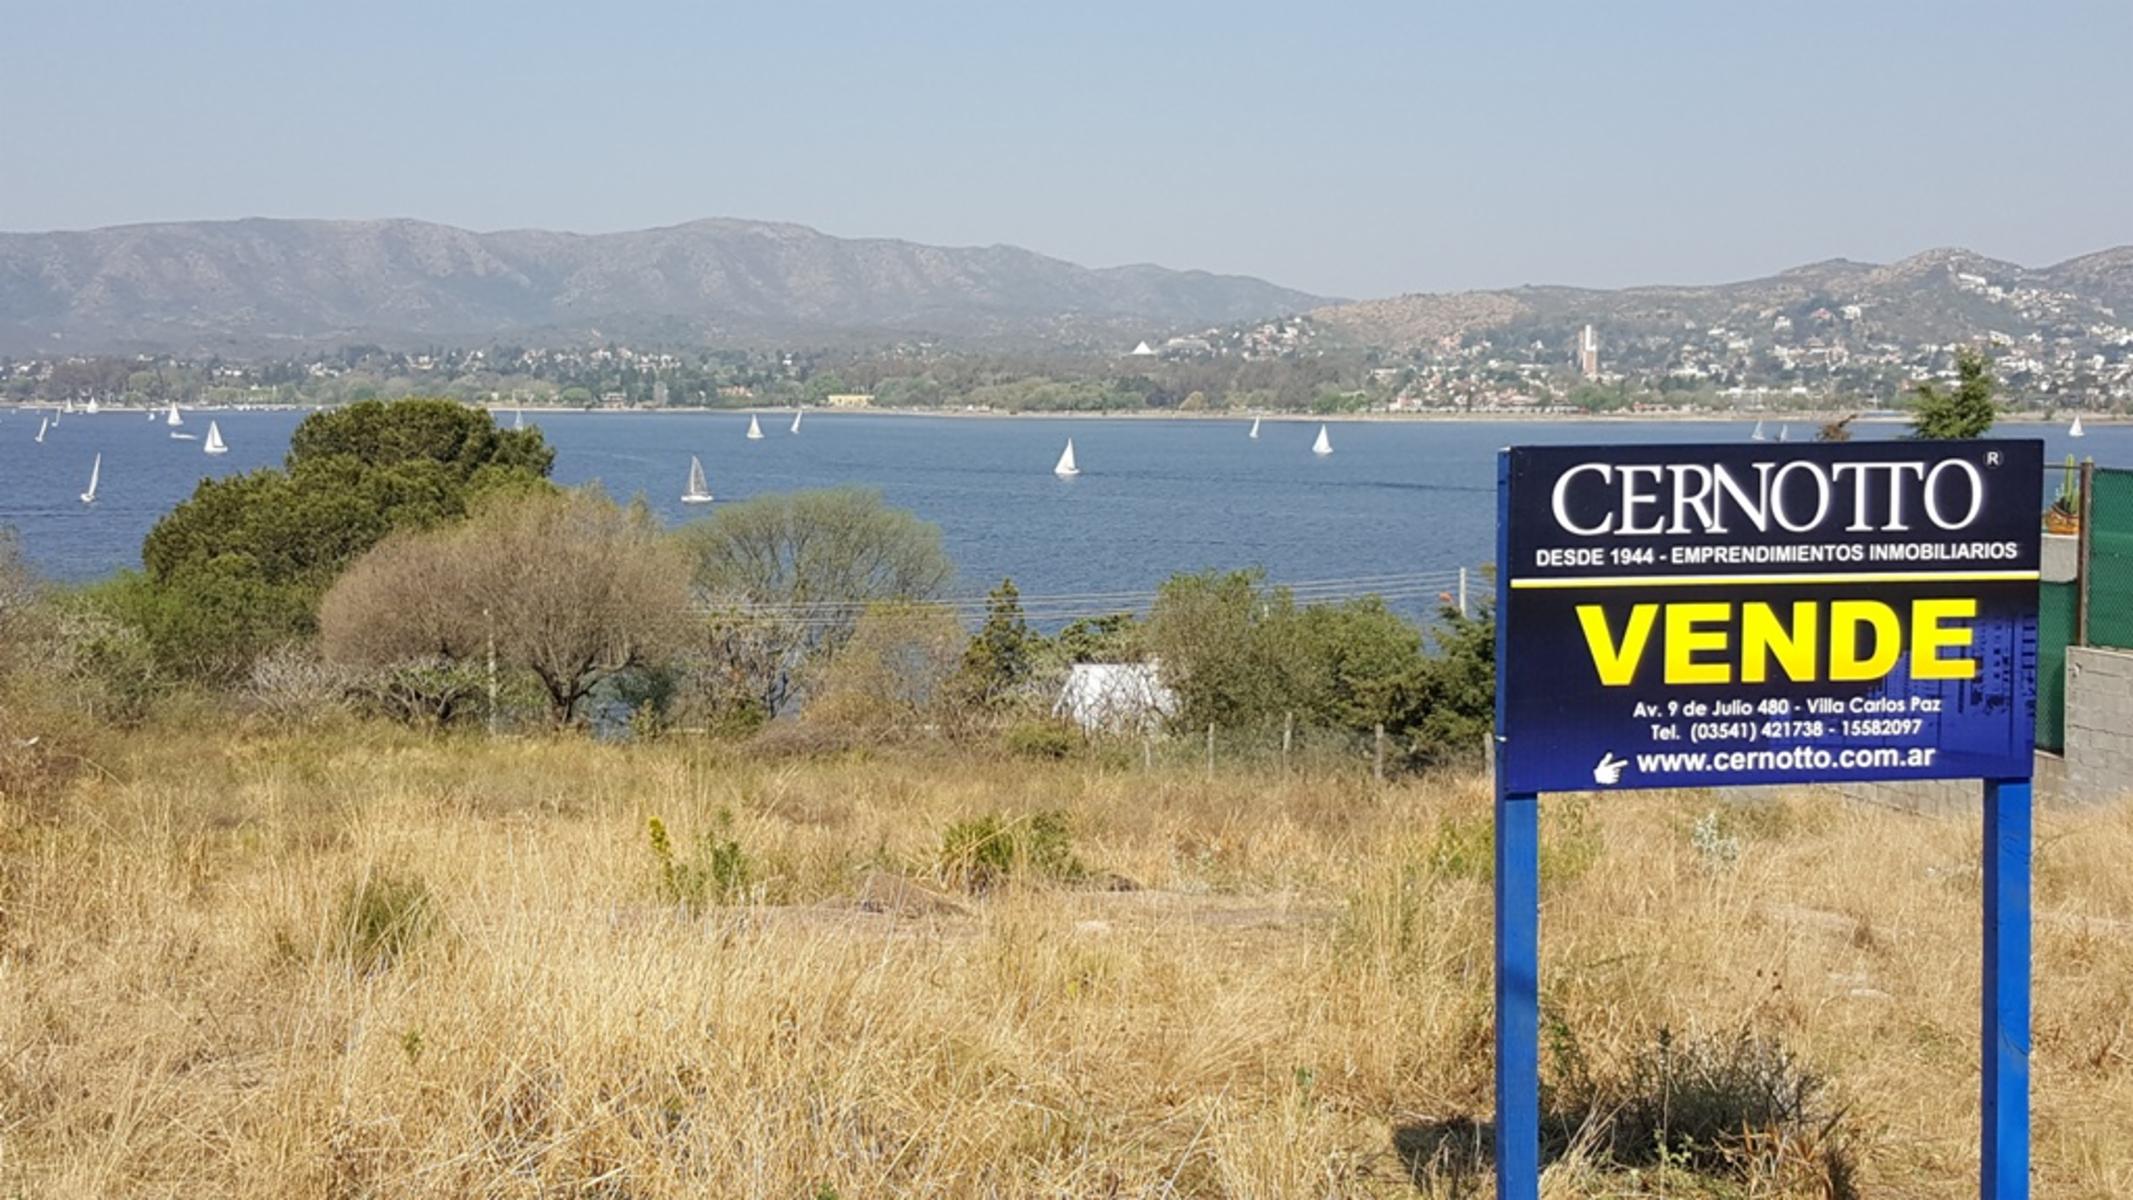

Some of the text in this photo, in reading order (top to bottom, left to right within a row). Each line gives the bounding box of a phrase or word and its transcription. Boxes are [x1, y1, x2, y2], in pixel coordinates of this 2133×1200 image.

[1552, 459, 1983, 535] CERNOTTO
[1536, 548, 1604, 566] DESDE
[1610, 548, 1655, 565] 1944
[1672, 544, 1864, 564] EMPRENDIMIENTOS
[1870, 542, 2018, 560] INMOBILIARIOS
[1576, 599, 1977, 685] VENDE
[1633, 702, 1662, 717] Av.
[1668, 701, 1678, 716] 9
[1683, 701, 1707, 717] de
[1712, 699, 1753, 716] Julio
[1757, 699, 1790, 715] 480
[1807, 698, 1844, 713] Villa
[1849, 697, 1906, 713] Carlos
[1910, 696, 1942, 712] Paz
[1651, 724, 1680, 740] Tel.
[1691, 722, 1757, 743] (03541)
[1761, 720, 1824, 738] 421738
[1842, 719, 1923, 736] 15582097
[1637, 746, 1936, 772] www.cernotto.com.ar
